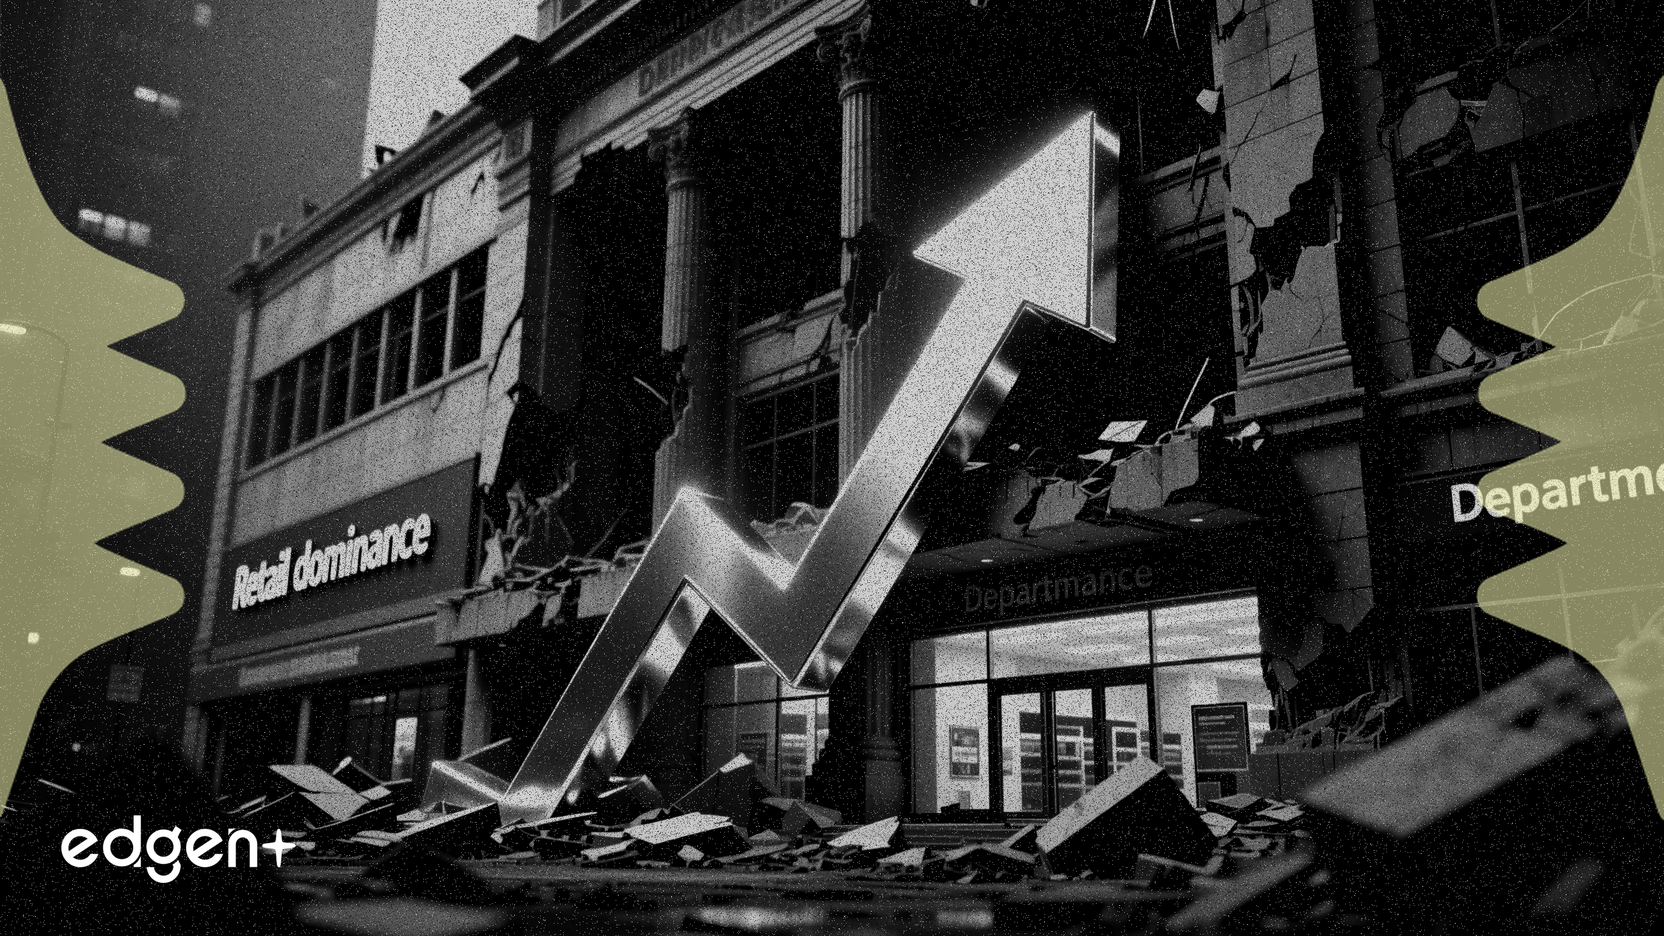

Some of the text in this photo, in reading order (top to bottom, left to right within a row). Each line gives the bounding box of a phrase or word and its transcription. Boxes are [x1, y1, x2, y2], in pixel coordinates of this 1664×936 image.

[231, 512, 432, 611] Retail dominance
[964, 564, 1153, 617] Departmance
